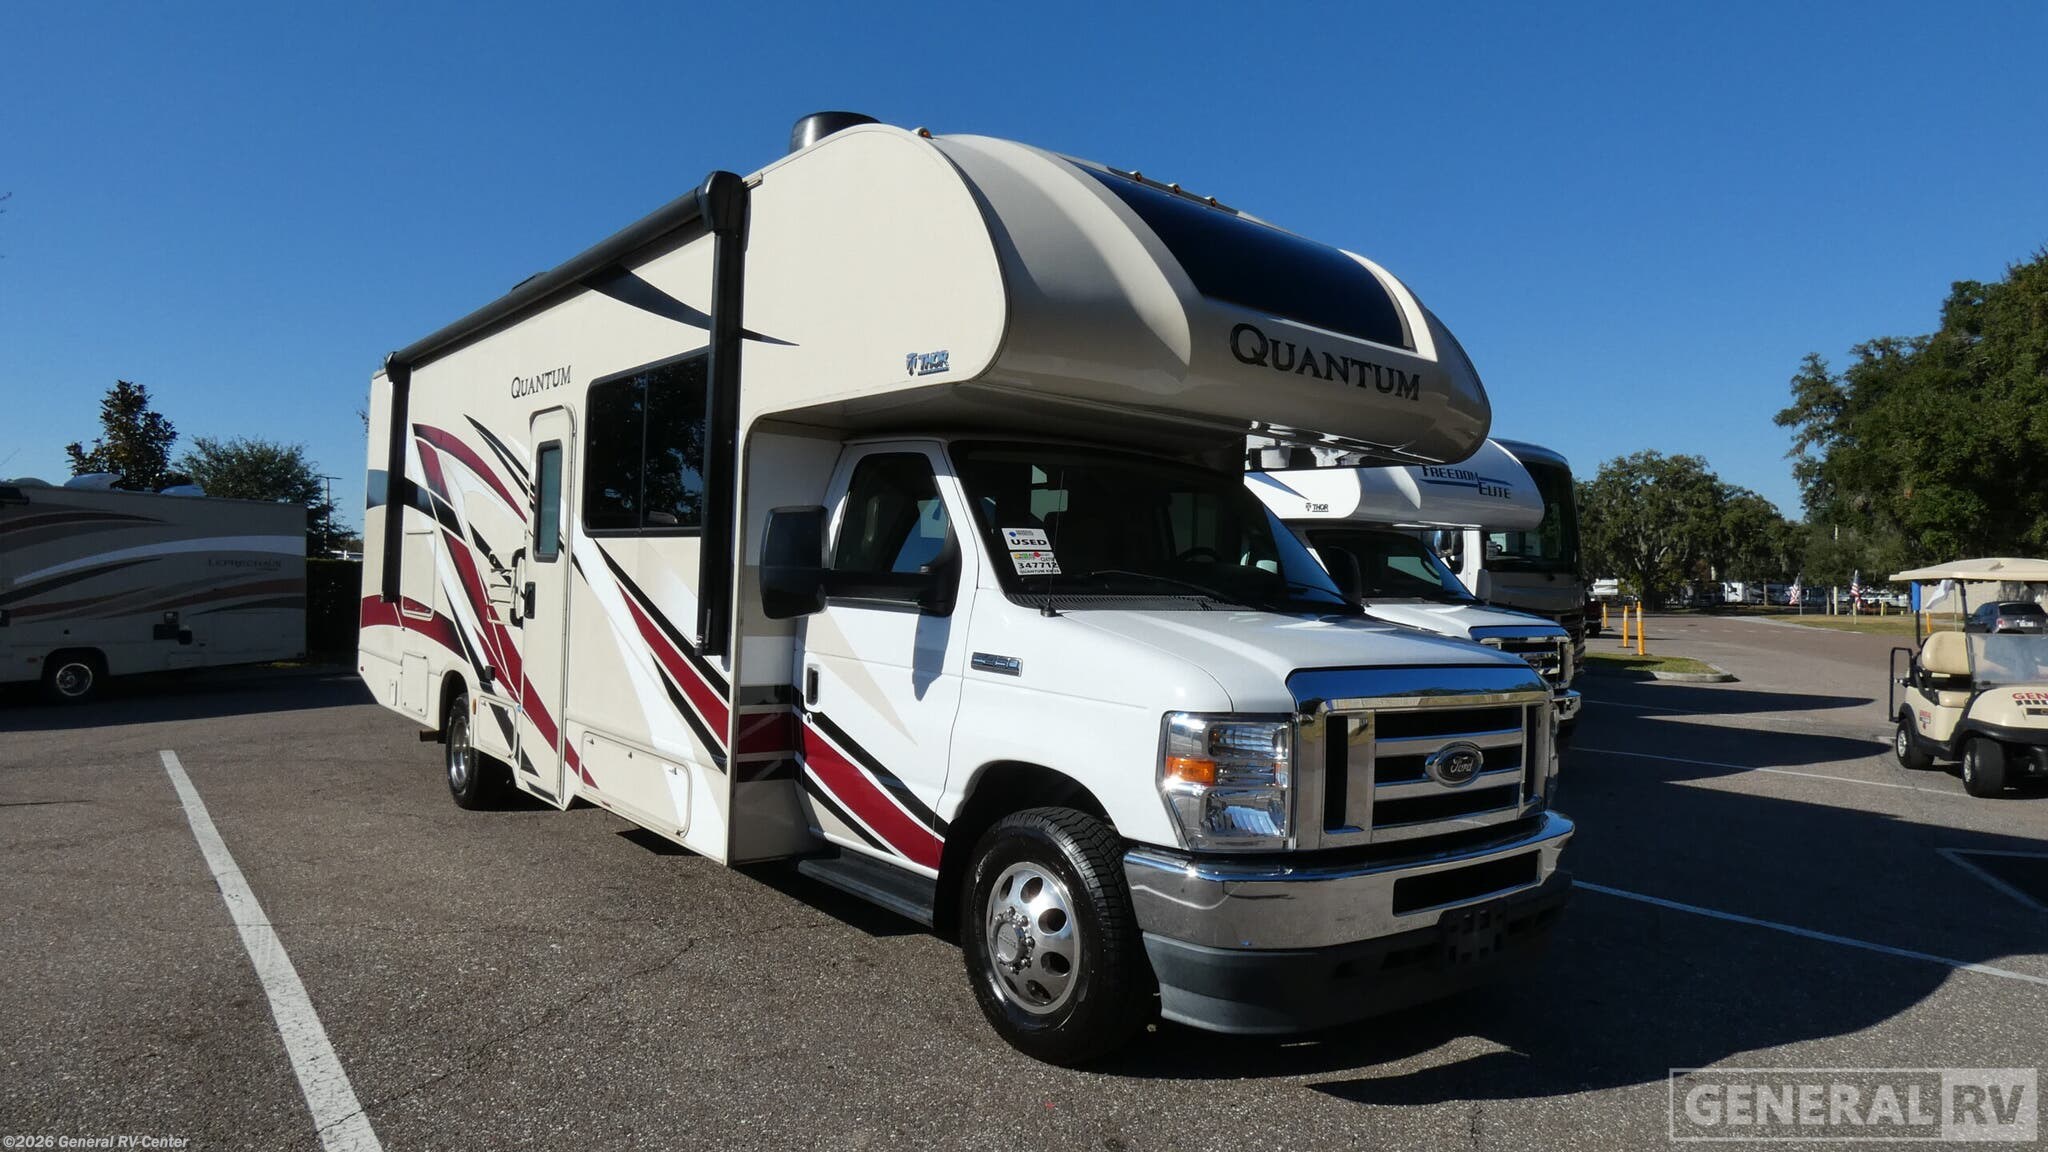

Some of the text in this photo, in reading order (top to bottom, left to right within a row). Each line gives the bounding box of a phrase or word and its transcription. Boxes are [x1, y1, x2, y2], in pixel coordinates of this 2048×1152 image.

[918, 351, 949, 371] THOR
[1230, 322, 1421, 401] QUANTUM
[511, 365, 571, 399] QUANTUM
[1421, 465, 1480, 481] FREEDOM
[1478, 480, 1511, 499] ELITE
[1312, 503, 1329, 512] THOR
[1450, 756, 1474, 773] Ford
